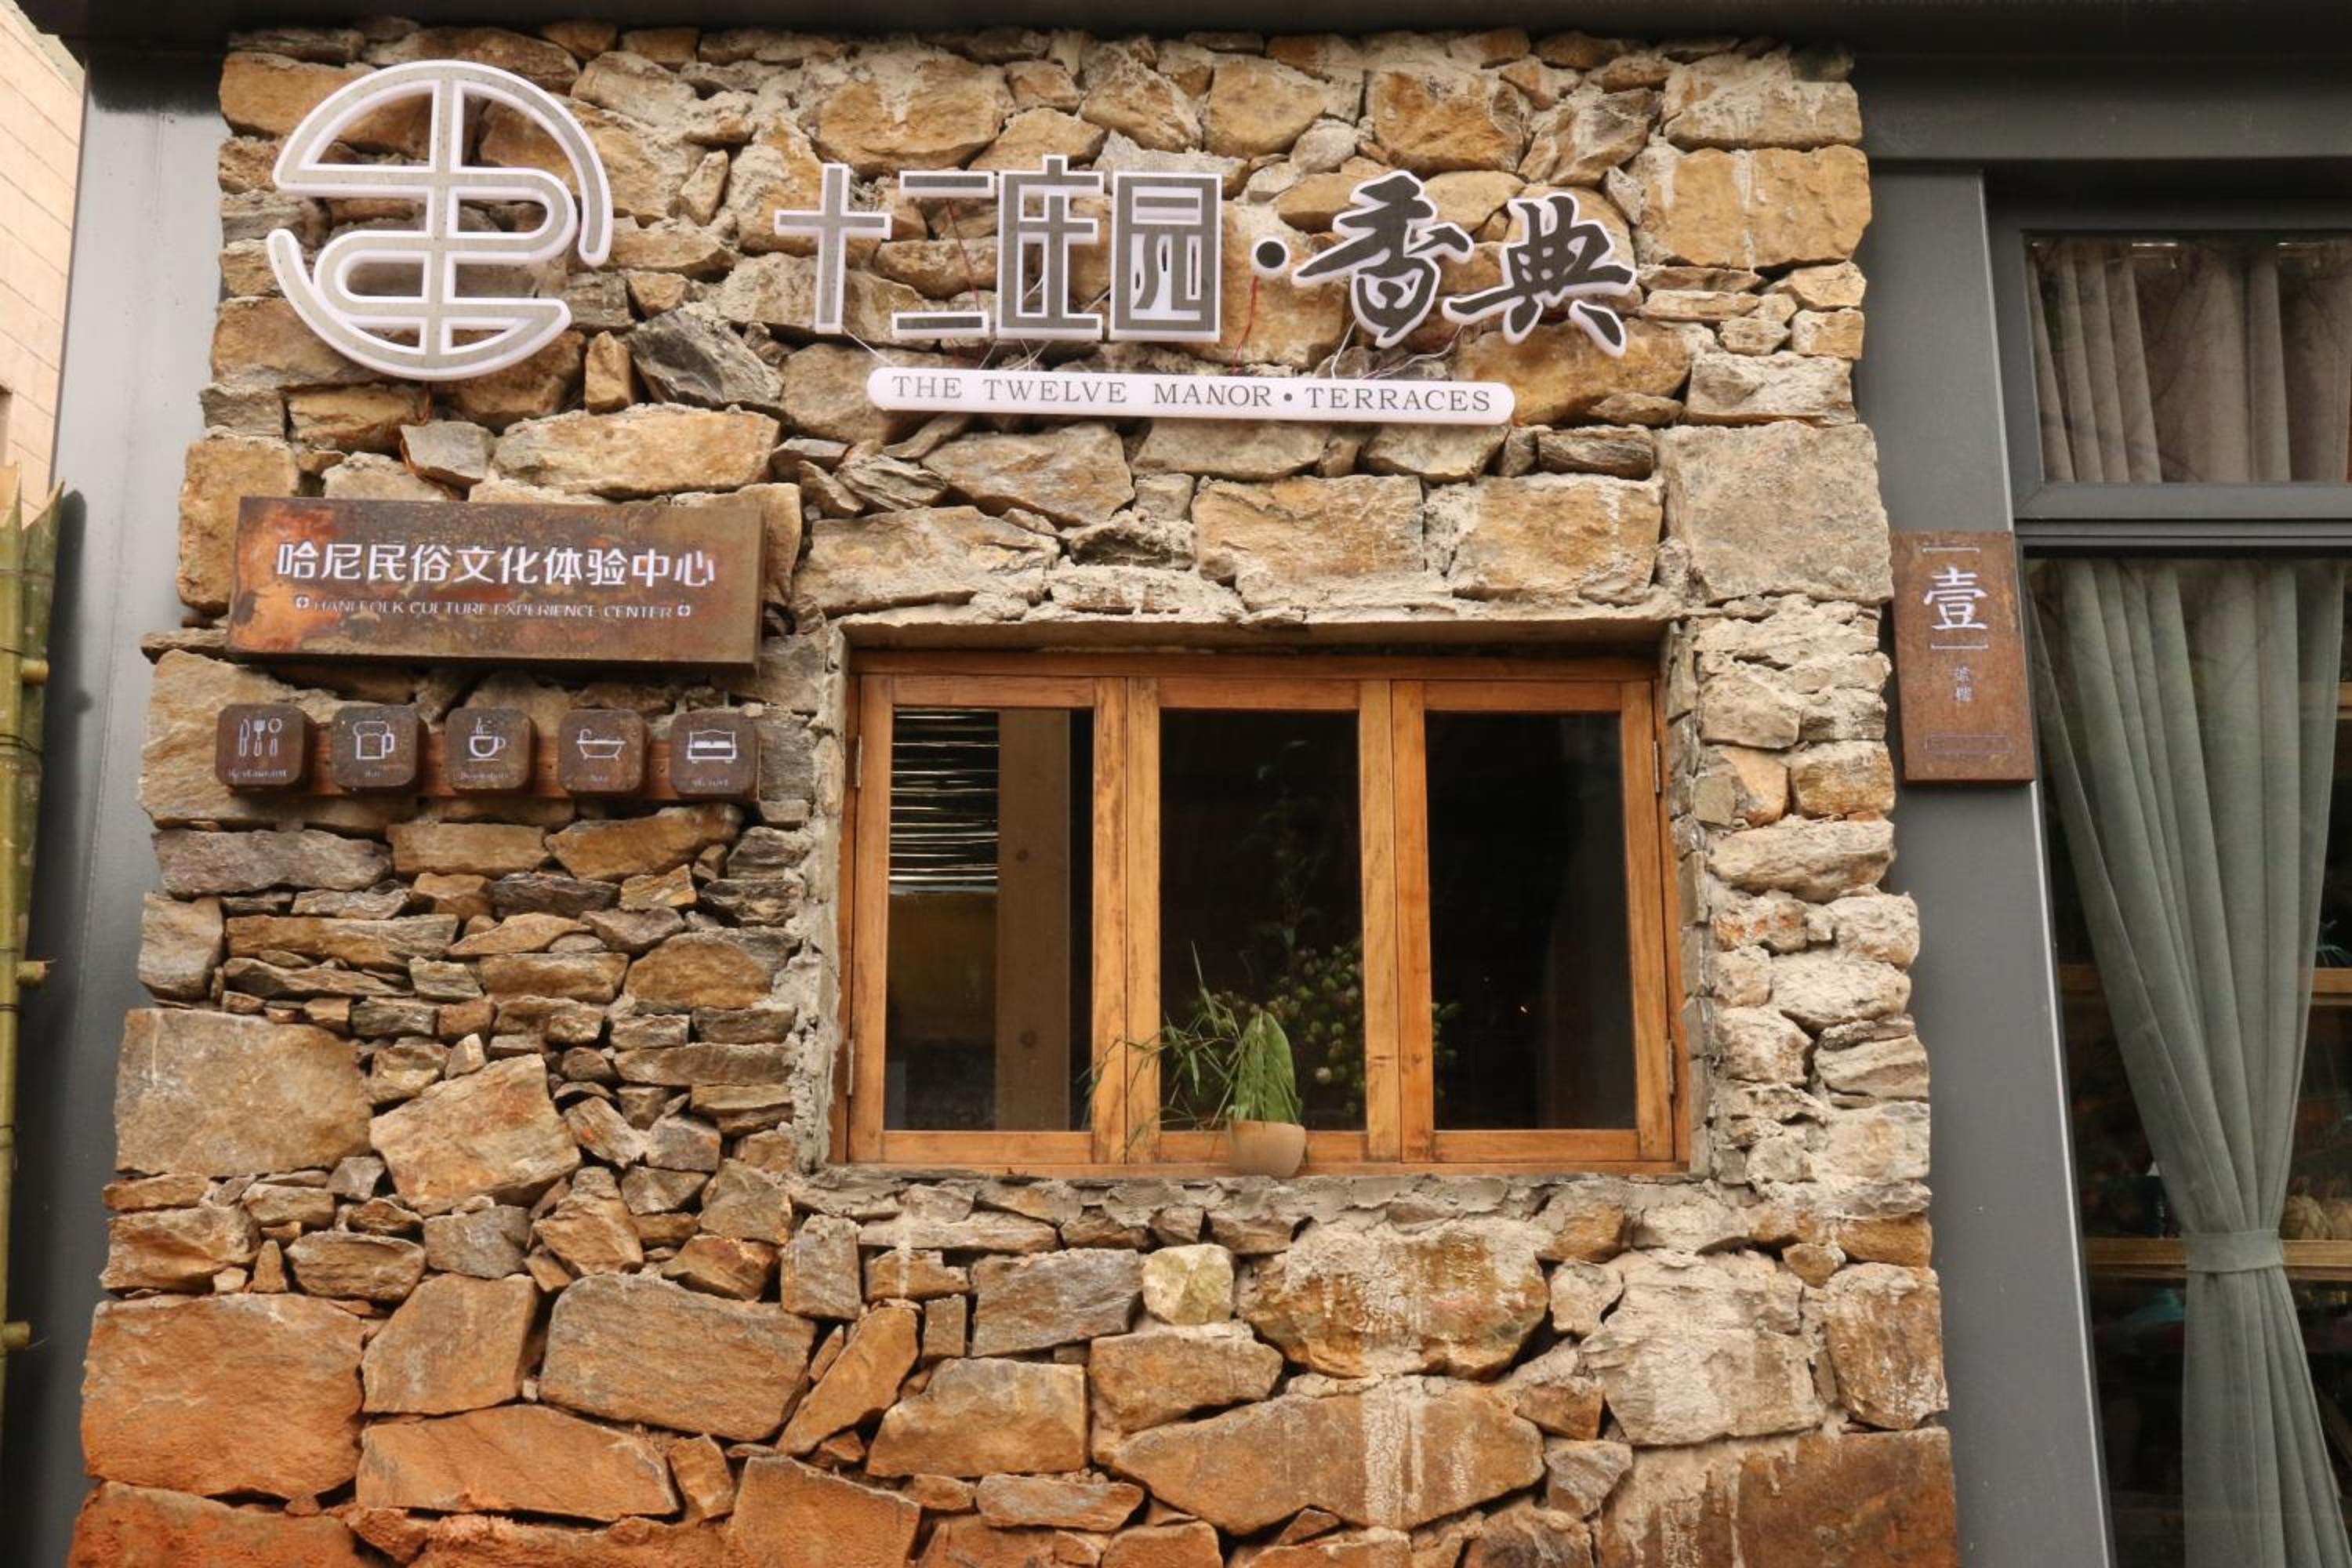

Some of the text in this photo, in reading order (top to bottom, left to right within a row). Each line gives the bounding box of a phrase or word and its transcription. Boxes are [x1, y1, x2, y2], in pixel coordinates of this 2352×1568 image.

[891, 376, 963, 398] THE
[982, 379, 1127, 404] TWELVE
[275, 541, 716, 589] 哈尼民俗文化体验中心
[408, 601, 485, 615] CULTURE
[493, 603, 595, 617] EXPERIENCE
[604, 605, 672, 619] CENTER
[1922, 566, 1989, 630] 壹
